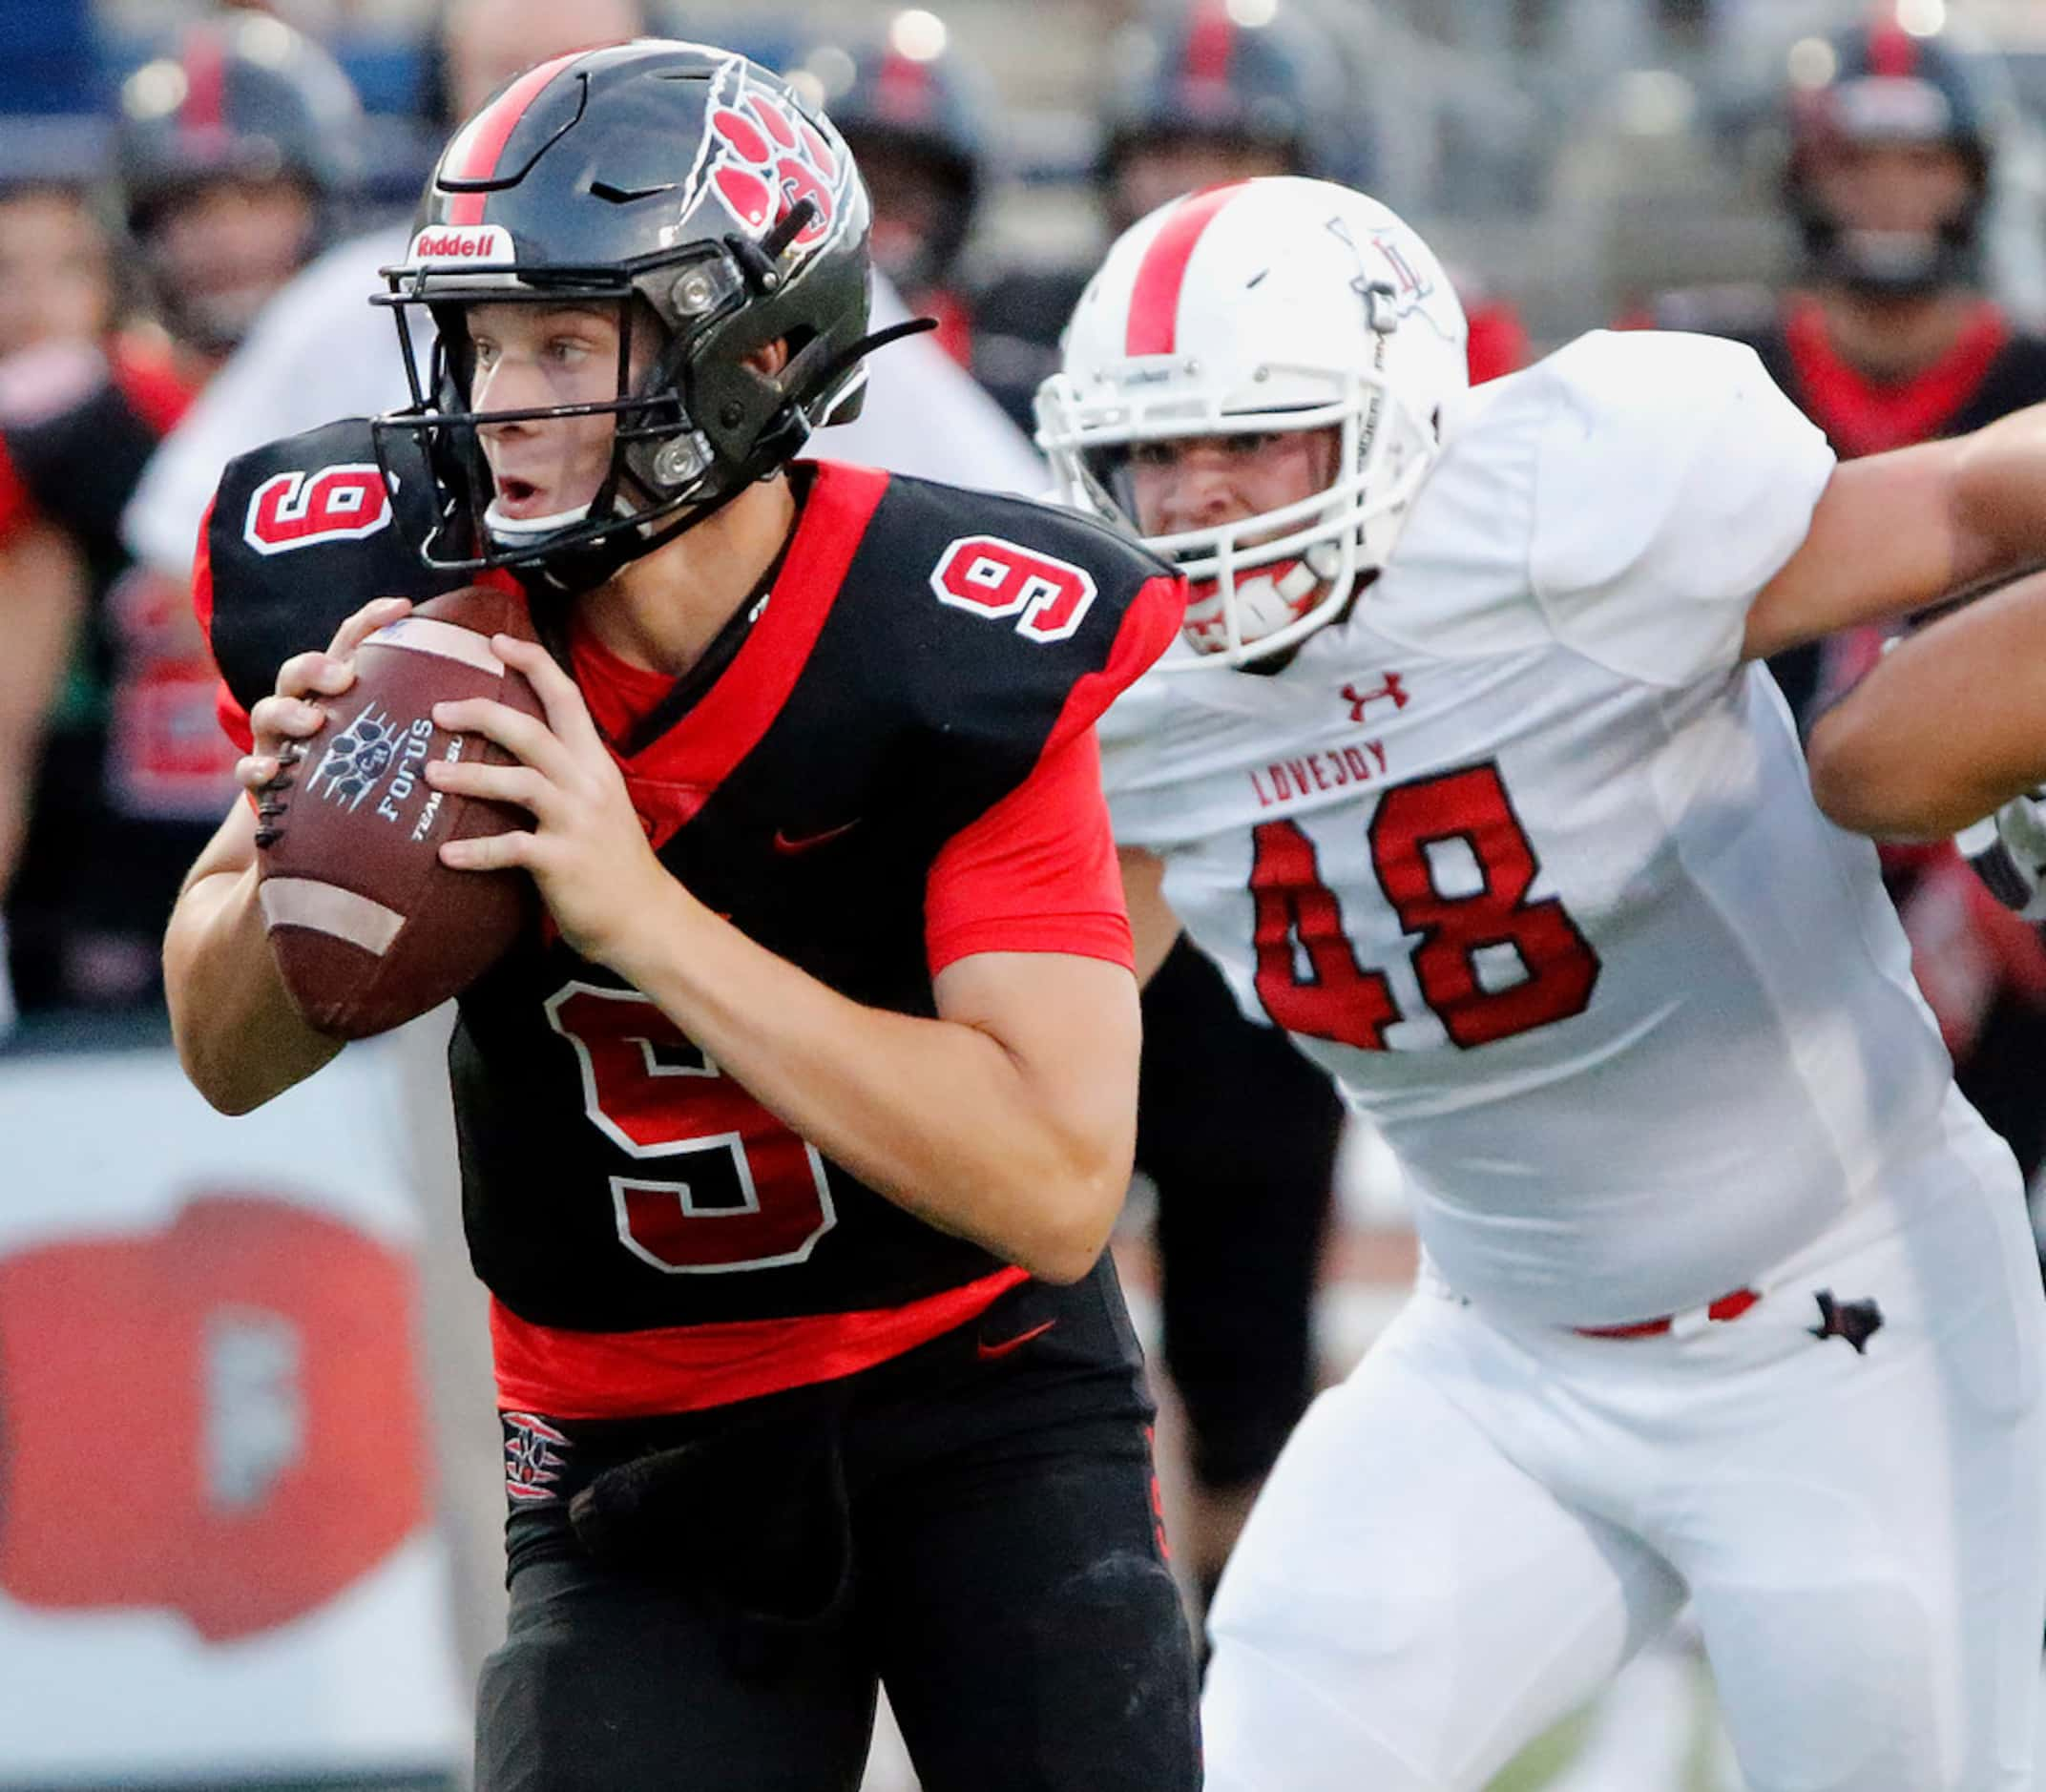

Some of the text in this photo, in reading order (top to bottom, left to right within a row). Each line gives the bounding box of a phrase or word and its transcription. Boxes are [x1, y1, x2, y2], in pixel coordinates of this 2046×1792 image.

[417, 235, 495, 257] Riddell
[243, 463, 401, 555] 9
[930, 534, 1098, 643] 9
[1249, 739, 1388, 807] LOVEJOY
[1248, 760, 1603, 1052] 48
[543, 980, 837, 1274] 9
